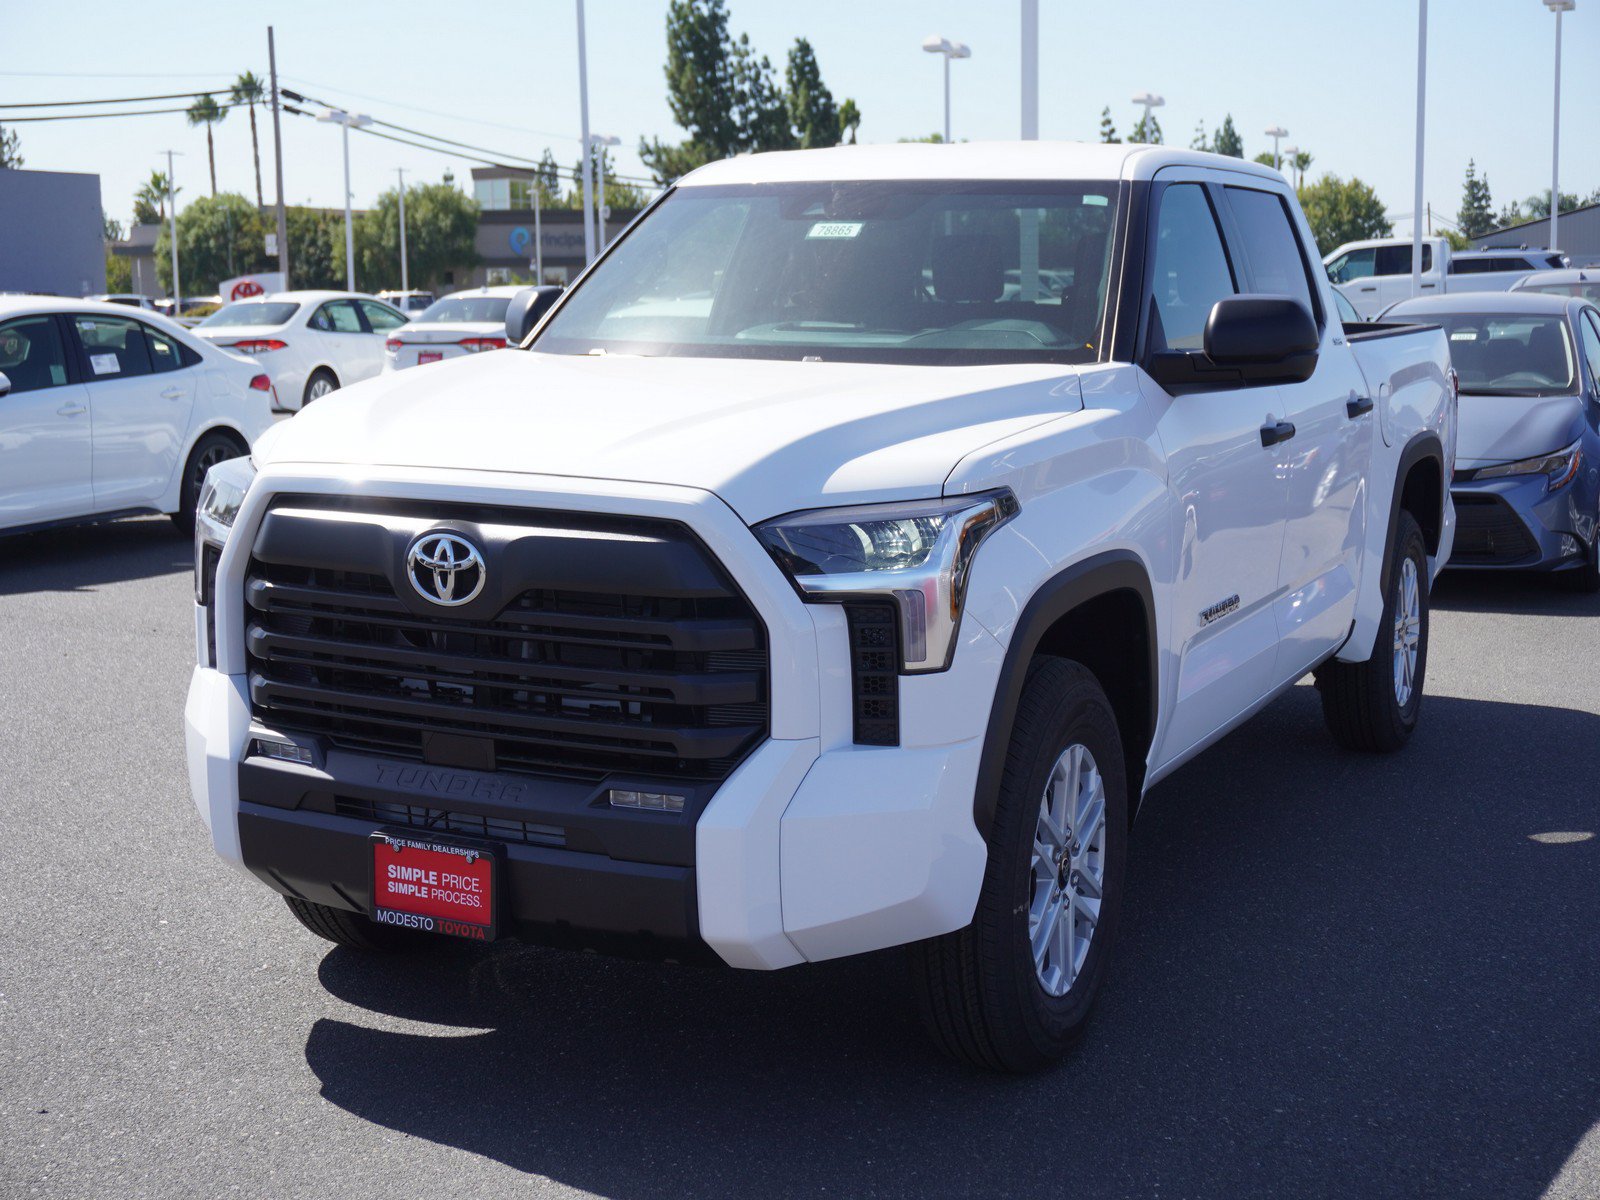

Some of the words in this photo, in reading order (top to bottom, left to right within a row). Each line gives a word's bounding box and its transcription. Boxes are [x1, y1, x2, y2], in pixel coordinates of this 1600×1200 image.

[377, 764, 528, 803] TUNDRA
[385, 837, 406, 847] PRICE
[407, 840, 431, 851] FAMILY
[433, 845, 480, 859] DEALERSHIPS
[387, 864, 438, 885] SIMPLE
[441, 873, 483, 893] PRICE.
[387, 881, 428, 898] SIMPLE
[431, 889, 483, 908] PROCESS.
[377, 910, 434, 931] MODESTO
[437, 920, 485, 940] TOYOTA
